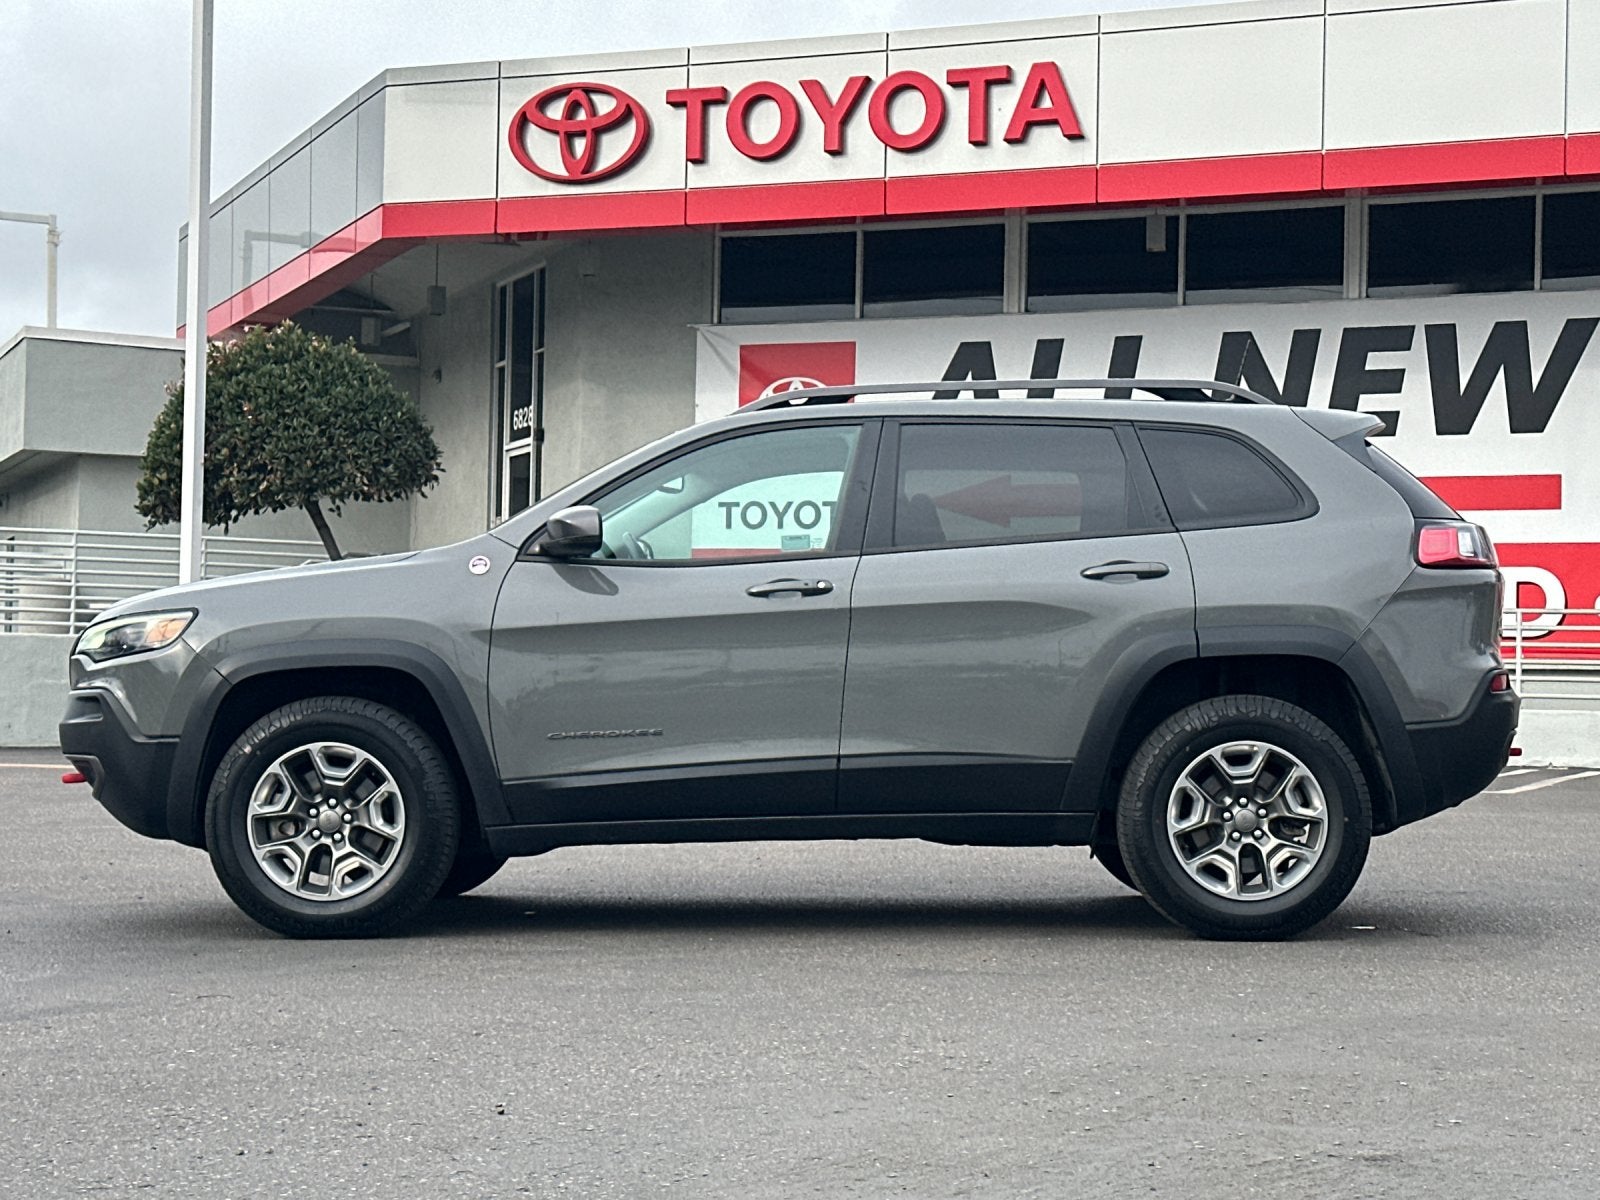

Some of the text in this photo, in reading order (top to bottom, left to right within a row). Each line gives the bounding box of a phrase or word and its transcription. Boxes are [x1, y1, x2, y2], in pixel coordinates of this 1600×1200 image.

[666, 61, 1084, 164] TOYOTA
[1211, 317, 1600, 438] NEW
[513, 405, 533, 430] 6828
[546, 728, 663, 740] CHEROKEE
